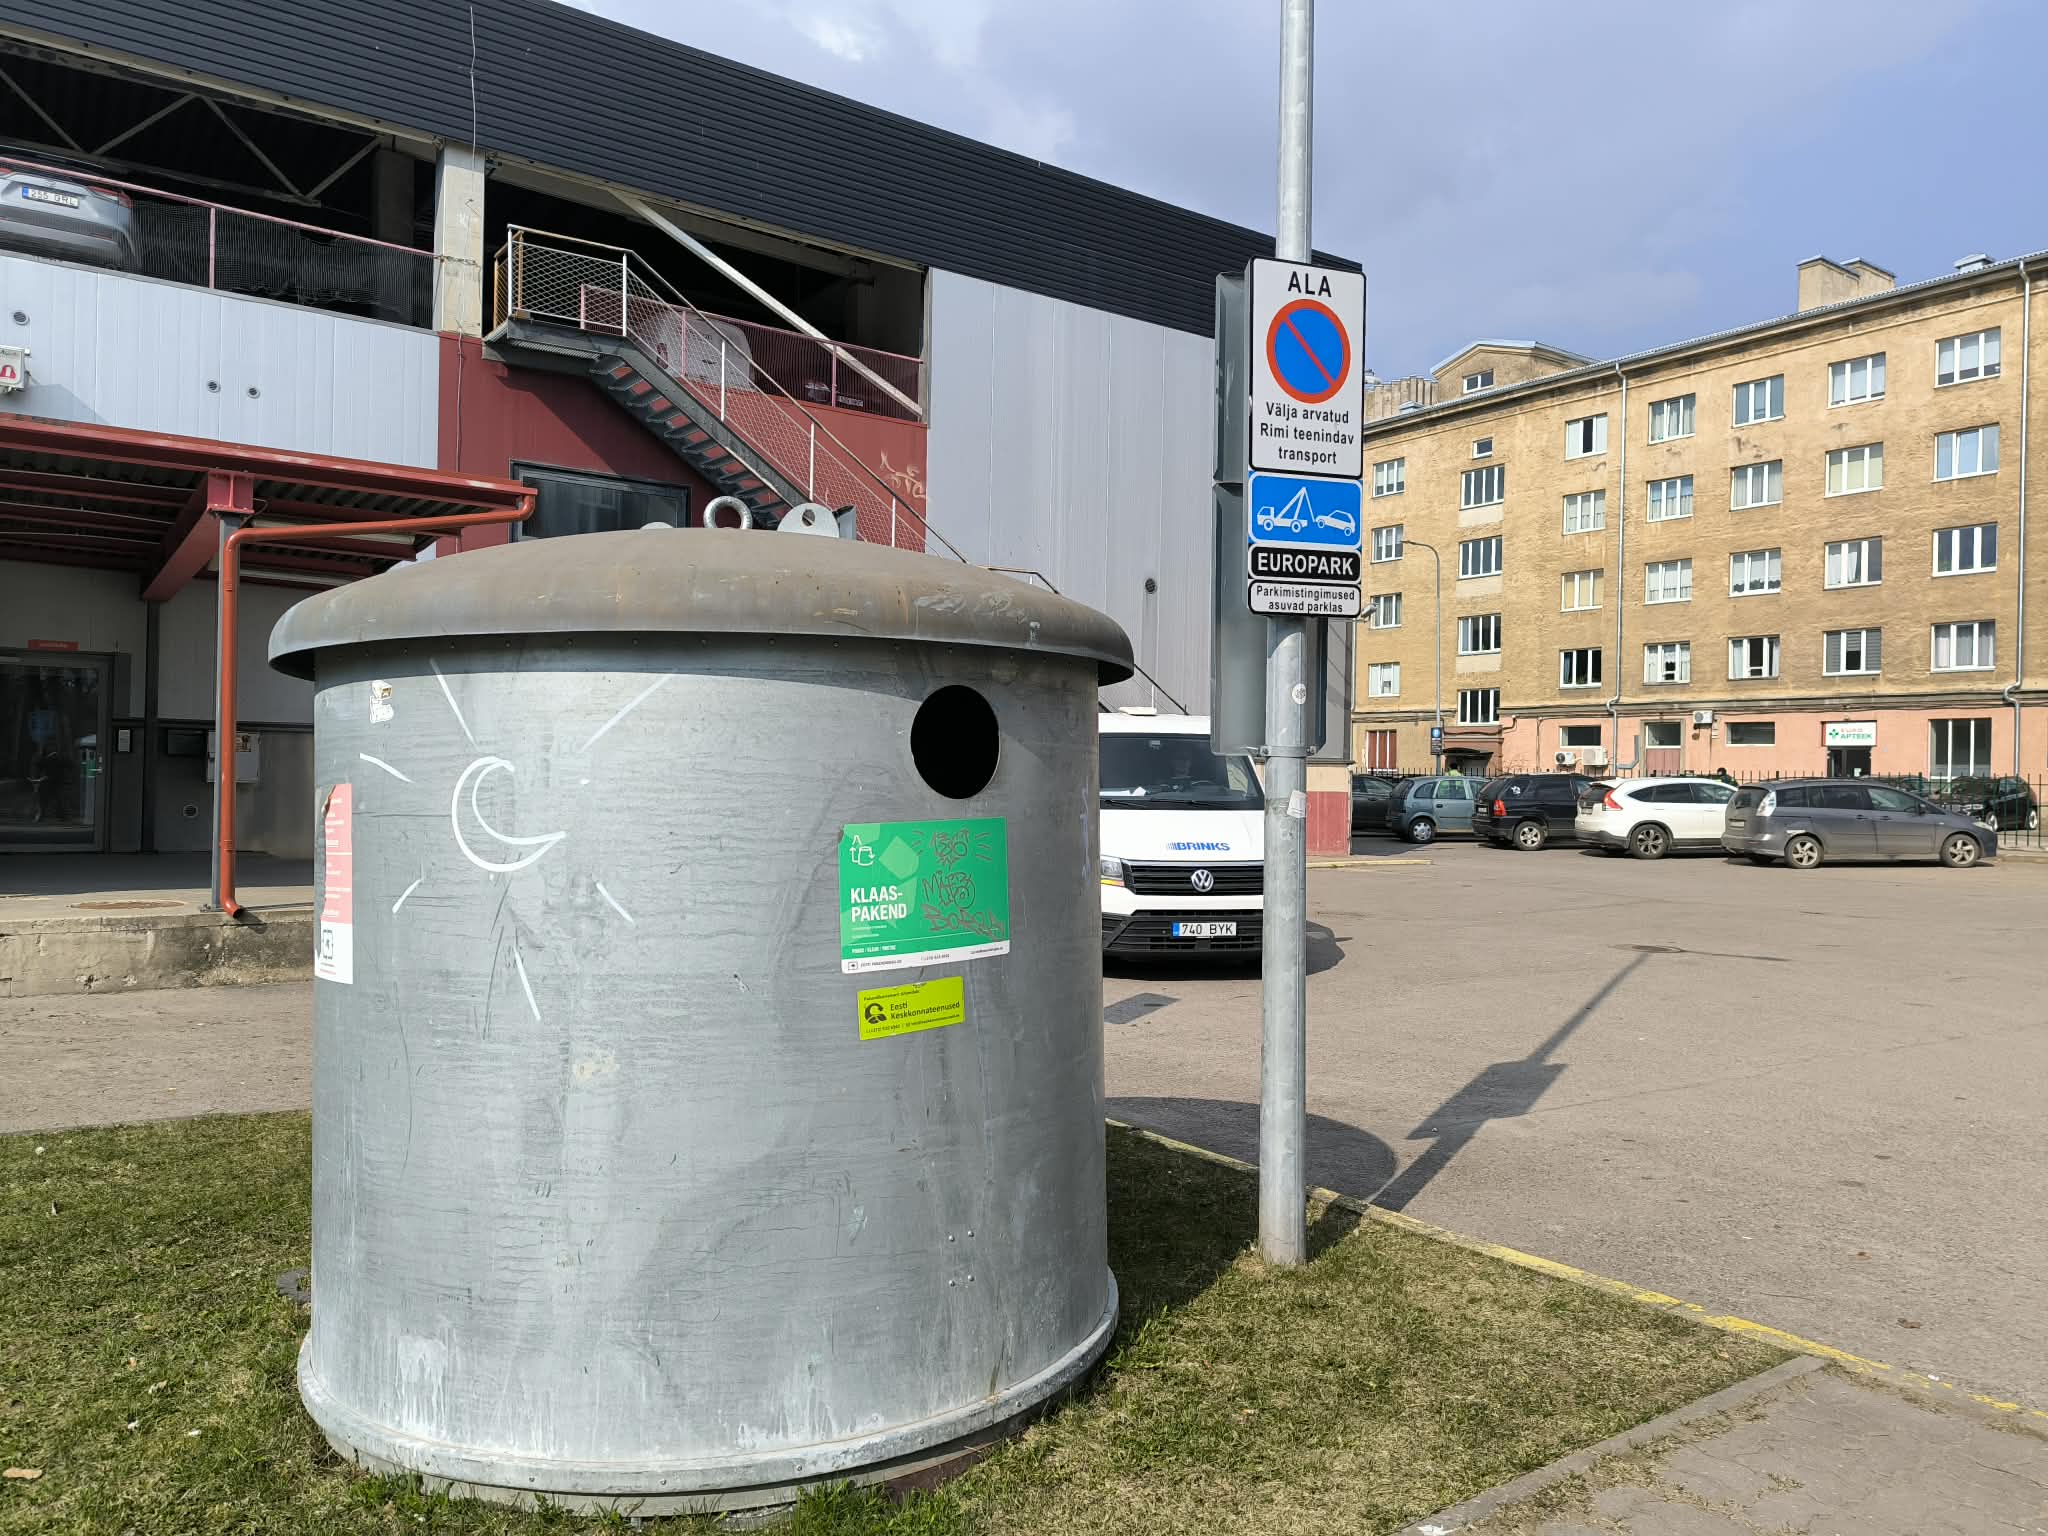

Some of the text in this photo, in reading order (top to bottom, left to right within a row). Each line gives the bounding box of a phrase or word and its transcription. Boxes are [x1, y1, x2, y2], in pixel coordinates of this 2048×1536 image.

[1287, 271, 1332, 298] ALA
[1266, 401, 1349, 424] Välja arvatud
[1260, 422, 1354, 445] Rimi teenindav
[1278, 446, 1337, 465] transport
[1257, 552, 1353, 576] EUROPARK
[1256, 585, 1355, 601] Parkimistingimused
[1268, 601, 1343, 614] asuvad parklas
[1174, 842, 1231, 851] BRINKS
[850, 885, 904, 904] KLAAS-
[851, 903, 908, 923] PAKEND
[1182, 924, 1233, 935] 740 BYK
[890, 1001, 908, 1011] Eesti
[890, 1001, 961, 1020] Keskkonnateenused
